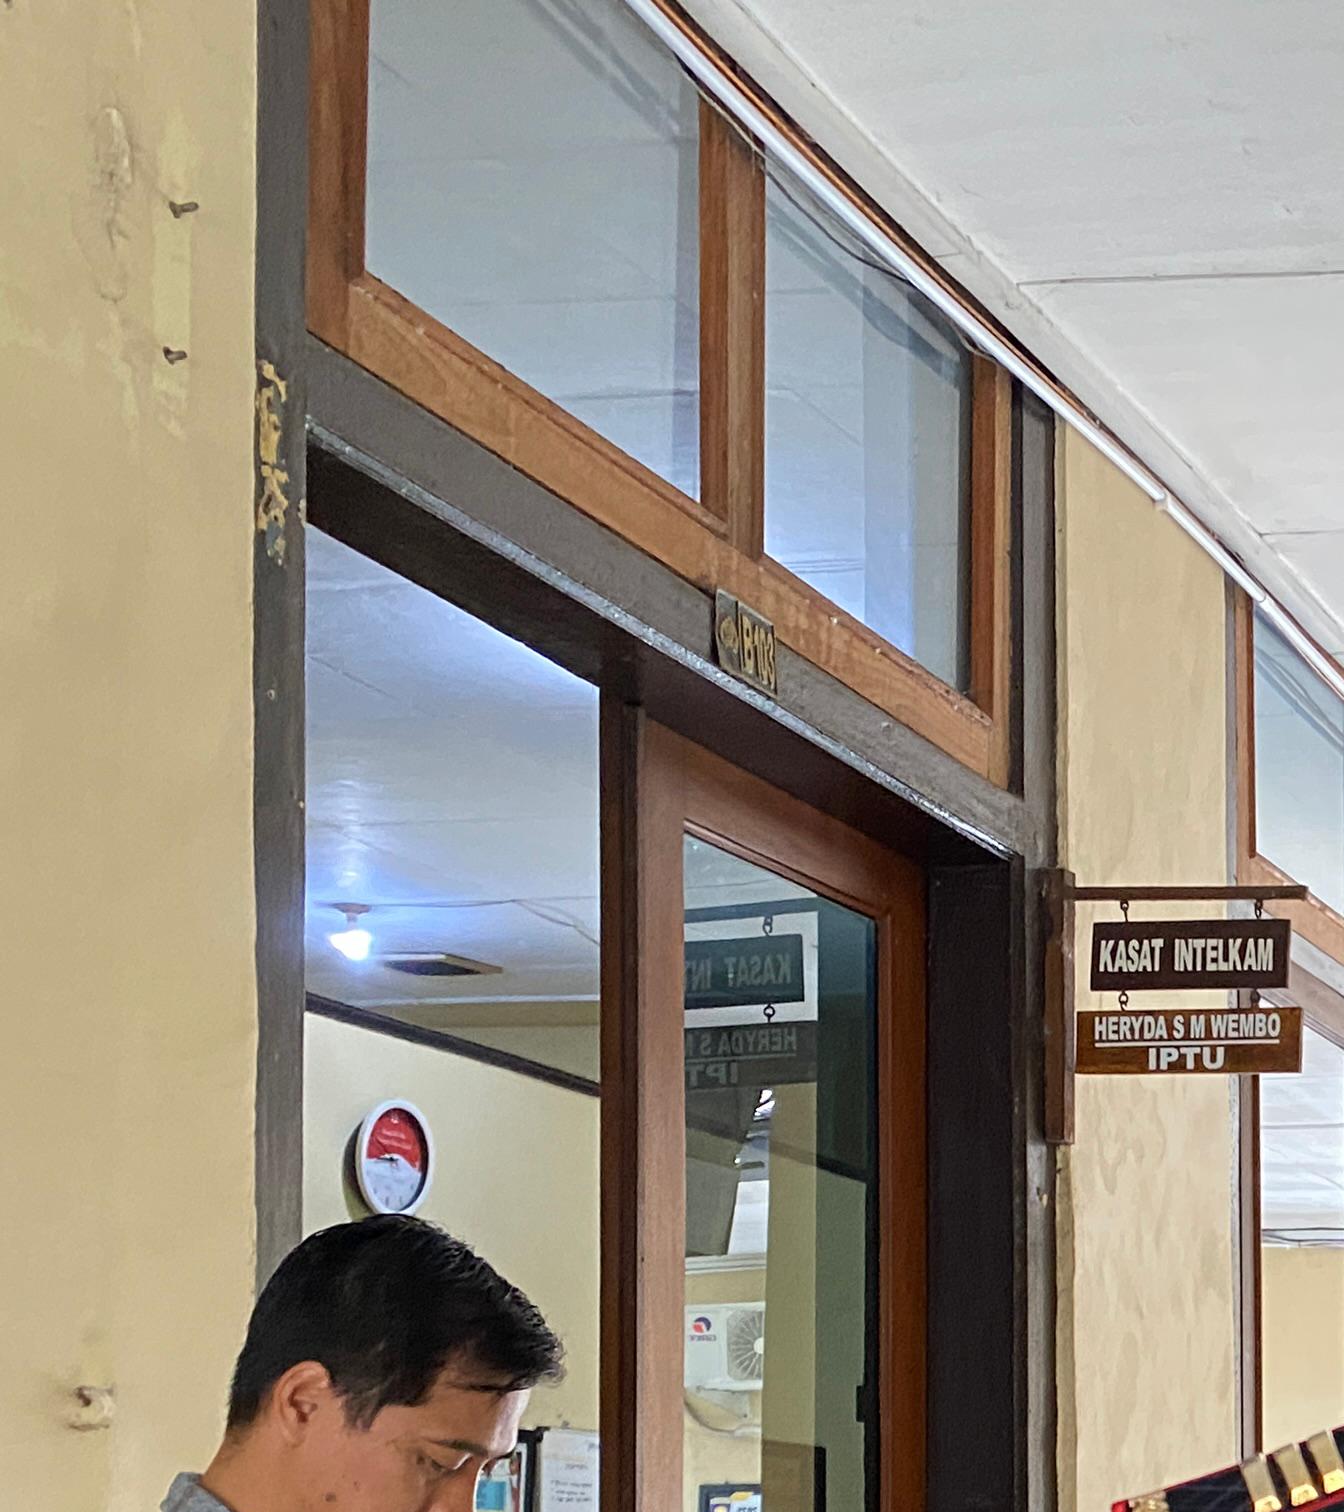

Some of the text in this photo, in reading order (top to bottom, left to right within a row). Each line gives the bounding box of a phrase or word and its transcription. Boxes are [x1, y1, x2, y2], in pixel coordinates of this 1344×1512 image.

[1099, 937, 1274, 972] KASAT INTELKAM
[1094, 1013, 1281, 1041] HERYDA S M WEMBO
[1148, 1046, 1225, 1070] IPTU
